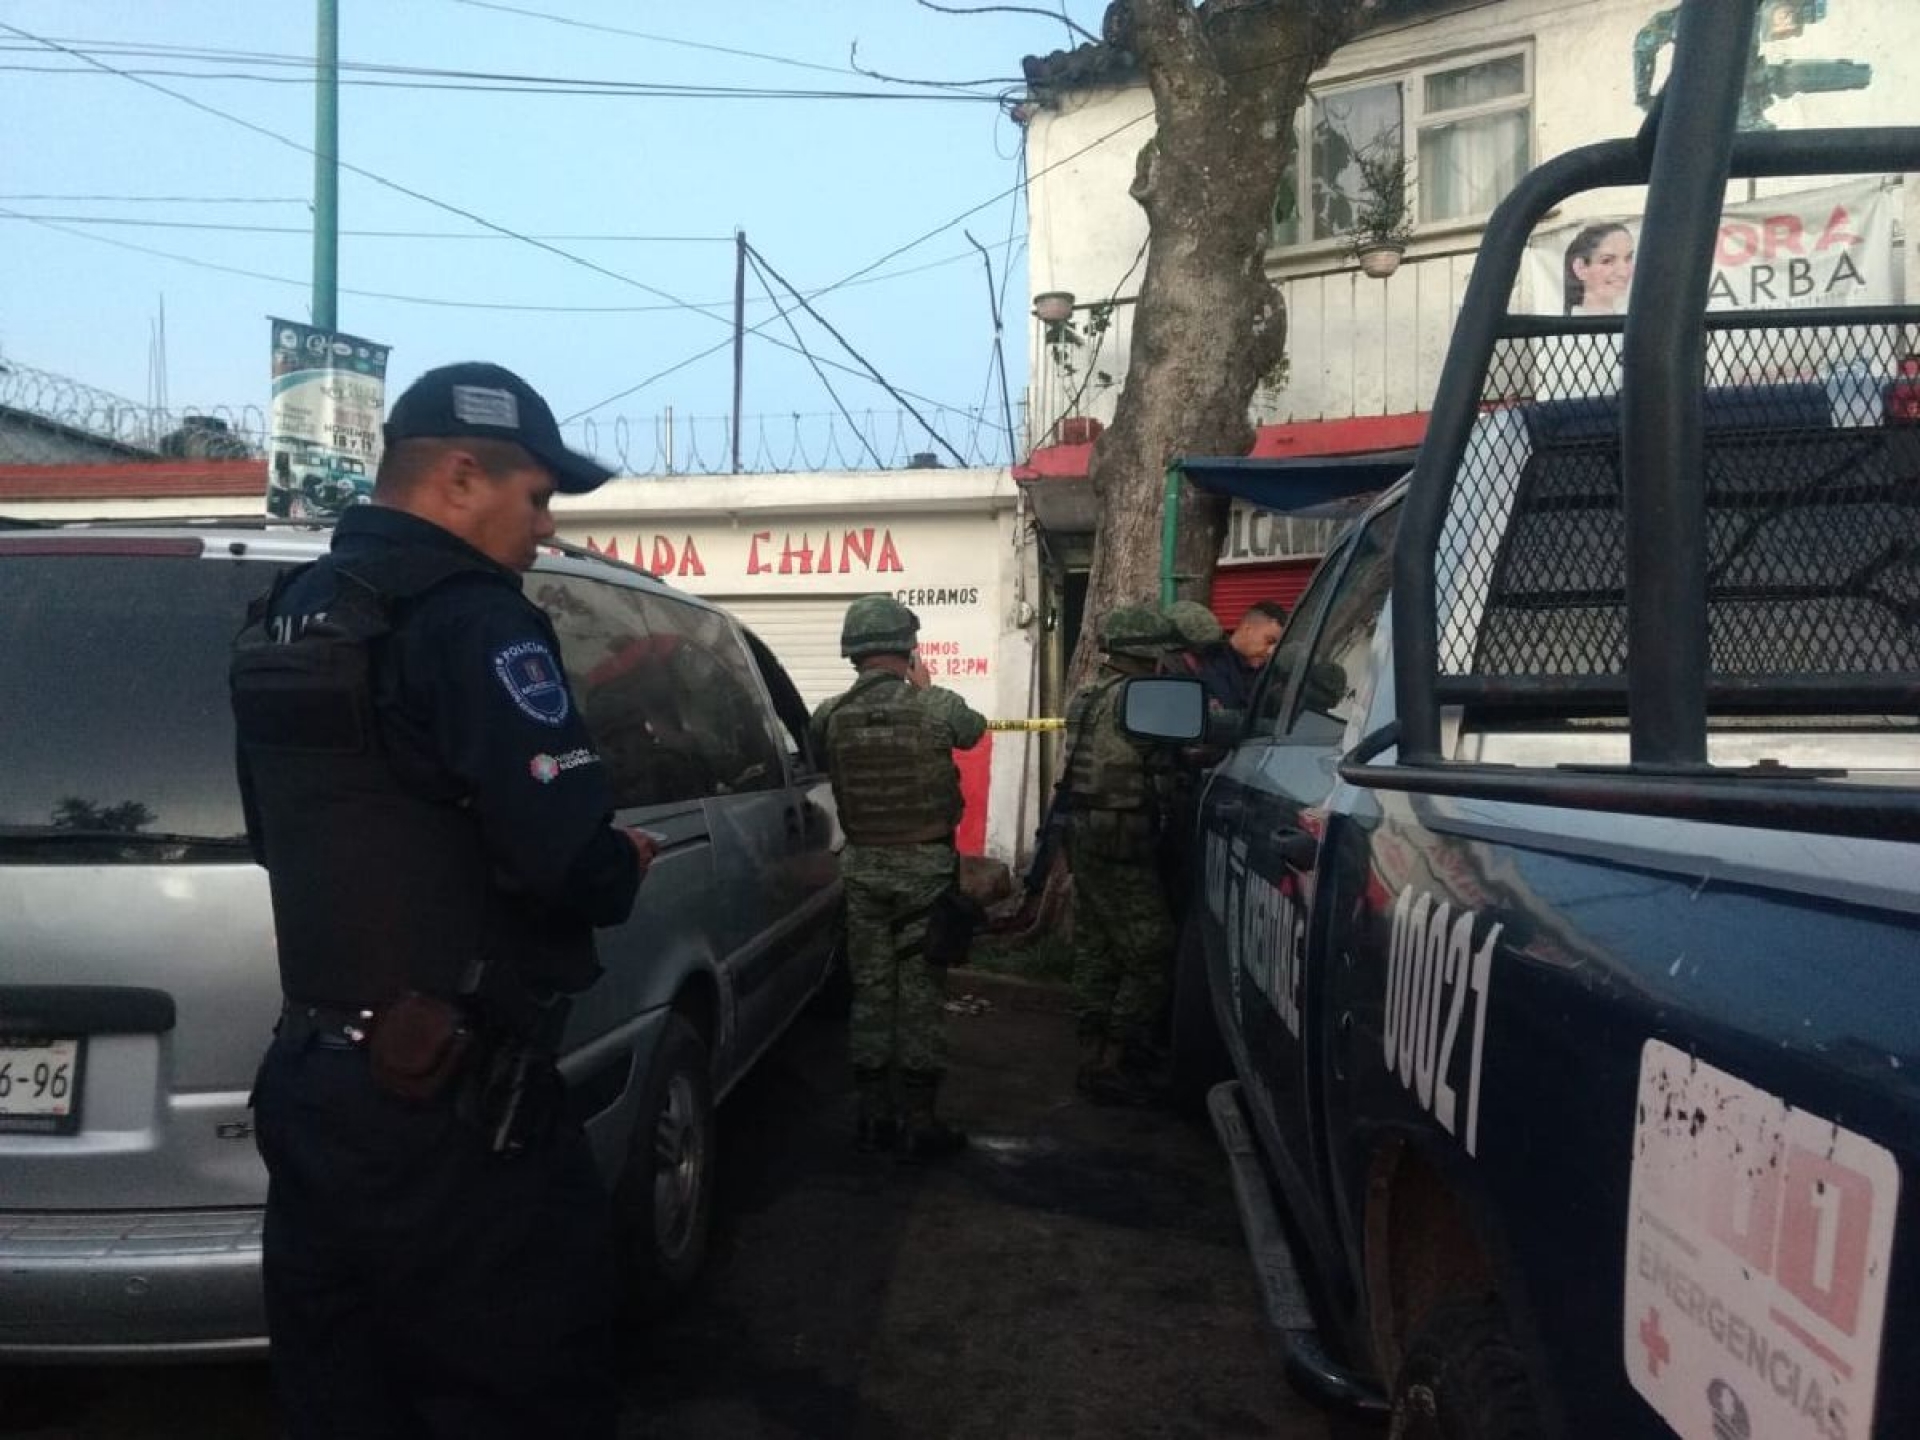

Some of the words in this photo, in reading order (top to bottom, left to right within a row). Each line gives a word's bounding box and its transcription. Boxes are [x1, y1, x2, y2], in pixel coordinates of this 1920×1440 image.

[1716, 205, 1865, 267] ORA
[1708, 250, 1866, 307] ARBA
[552, 534, 706, 577] MIDA
[747, 528, 904, 574] CHINA
[897, 588, 979, 606] CERRAMOS
[1384, 882, 1505, 1159] 00021
[0, 1062, 68, 1099] 6-96
[1637, 1241, 1850, 1440] EMERGENCIAS
